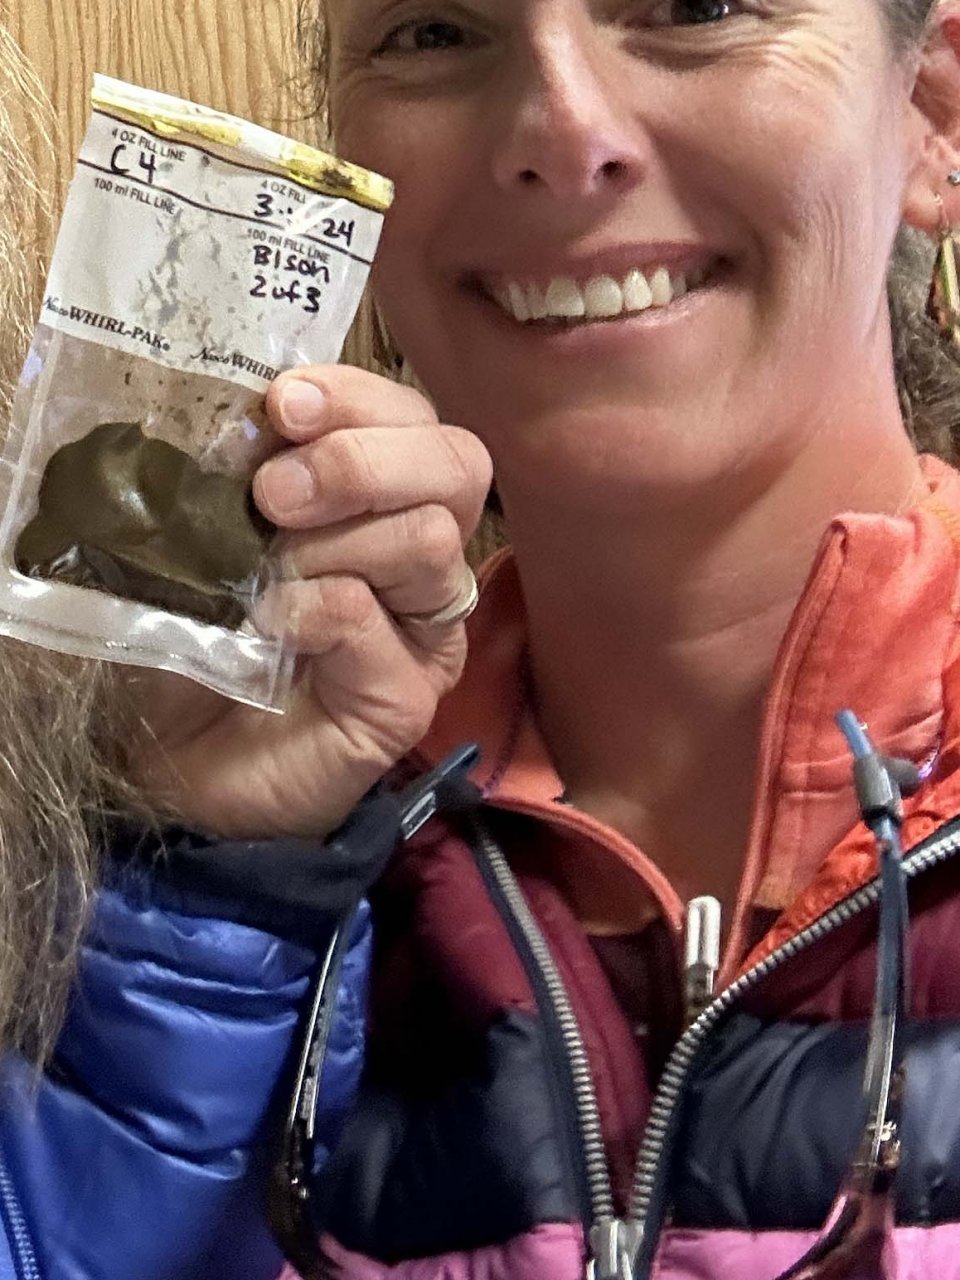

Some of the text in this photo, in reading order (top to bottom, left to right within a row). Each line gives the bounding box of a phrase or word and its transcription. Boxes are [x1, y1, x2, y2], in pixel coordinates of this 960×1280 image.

[112, 128, 187, 161] 4 OZ FILL LINE
[94, 178, 176, 214] 100 ml FILL LINE
[262, 180, 268, 189] 4
[271, 182, 286, 196] OZ
[247, 228, 330, 264] 100 ml FILL LINE
[249, 275, 321, 313] 2 of 3
